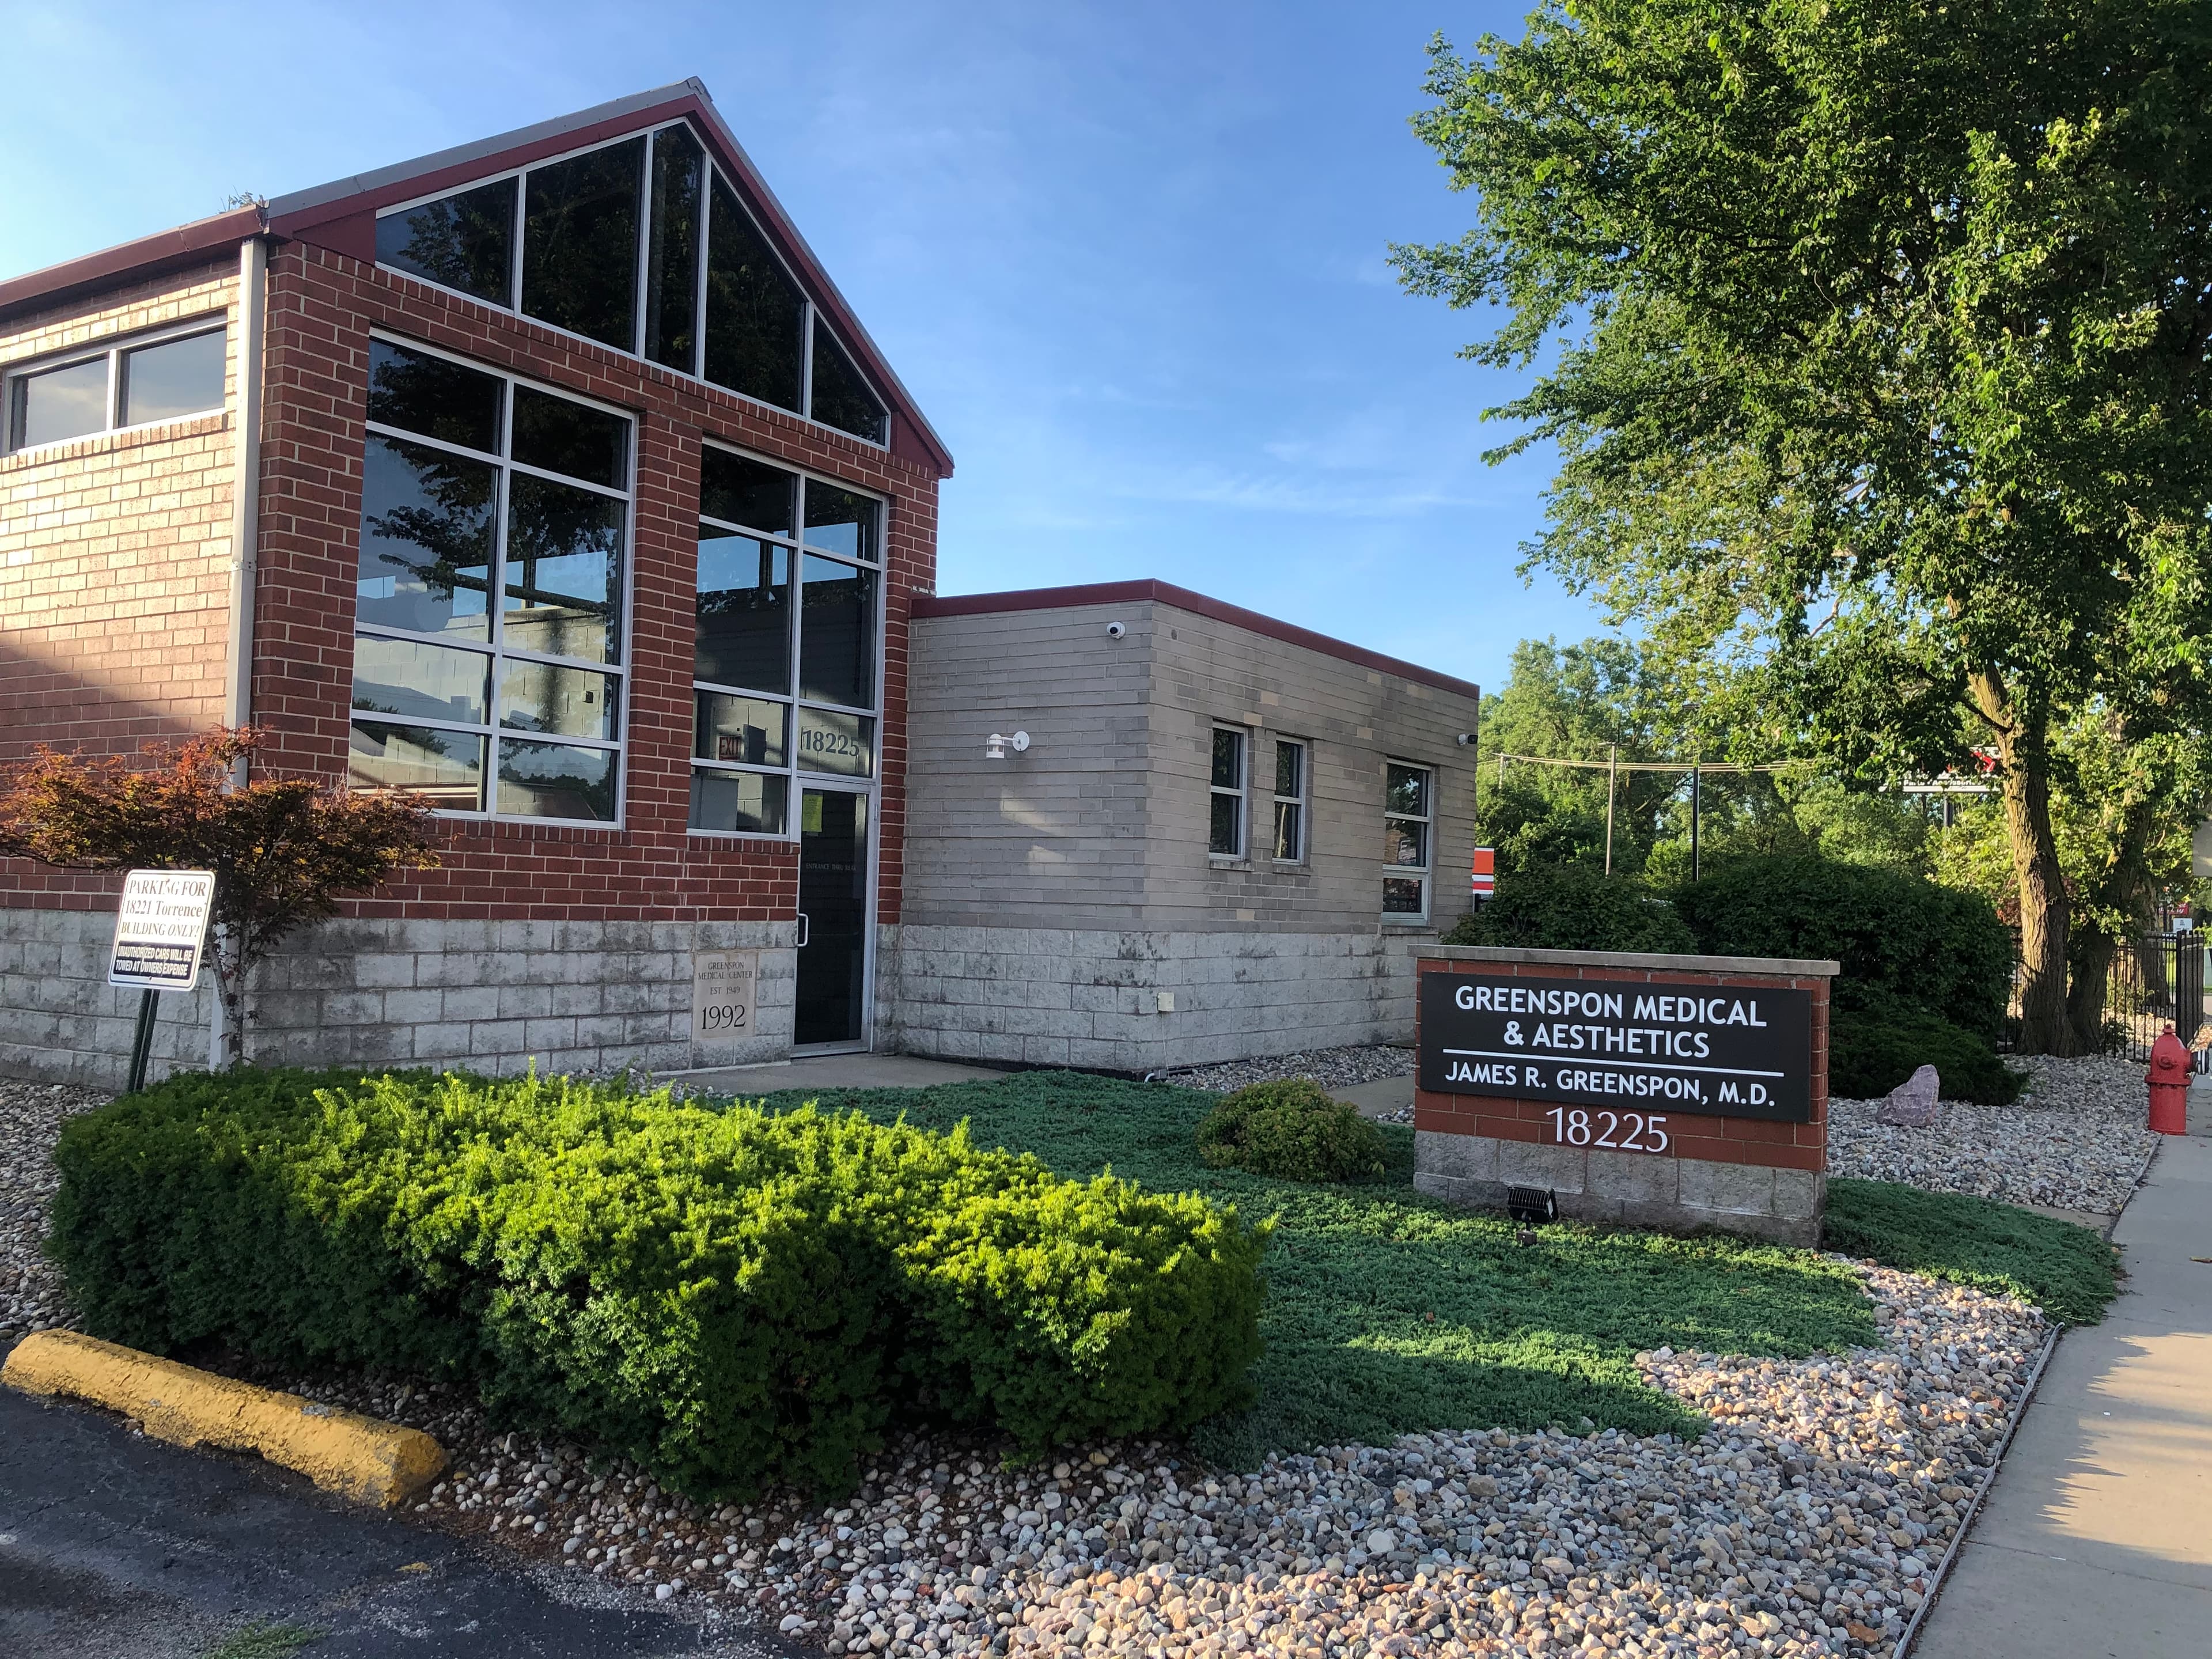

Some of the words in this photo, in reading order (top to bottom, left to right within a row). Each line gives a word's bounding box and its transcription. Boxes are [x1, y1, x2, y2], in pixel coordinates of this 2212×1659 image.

[719, 737, 741, 755] EXIT
[803, 730, 859, 756] 18225
[129, 880, 180, 895] PARKING
[181, 881, 206, 896] FOR
[126, 900, 151, 915] 18221
[156, 900, 202, 917] Torrence
[120, 922, 166, 935] BUILDING
[168, 925, 200, 938] ONLY!
[118, 945, 154, 959] UNAUTHORIZED
[155, 948, 170, 960] CARS
[171, 949, 184, 961] WILL
[184, 950, 193, 961] BE
[116, 960, 132, 971] TOWED
[132, 961, 141, 971] AT
[141, 961, 162, 974] OWNERS
[163, 964, 188, 975] EXPENSE
[708, 961, 744, 970] GREENSPON
[698, 972, 724, 980] MEDICAL
[729, 971, 752, 979] CENTER
[710, 987, 721, 995] EST
[726, 986, 740, 994] 1949
[1455, 985, 1623, 1019] GREENSPON
[1633, 995, 1767, 1027] MEDICAL
[702, 1005, 745, 1029] 1992
[1503, 1020, 1525, 1046] &
[1532, 1023, 1710, 1059] AESTHETICS
[1445, 1061, 1517, 1086] JAMES
[1525, 1067, 1547, 1089] R.
[1556, 1069, 1709, 1104] GREENSPON,
[1718, 1084, 1775, 1107] M.D.
[1546, 1106, 1668, 1153] 18225
